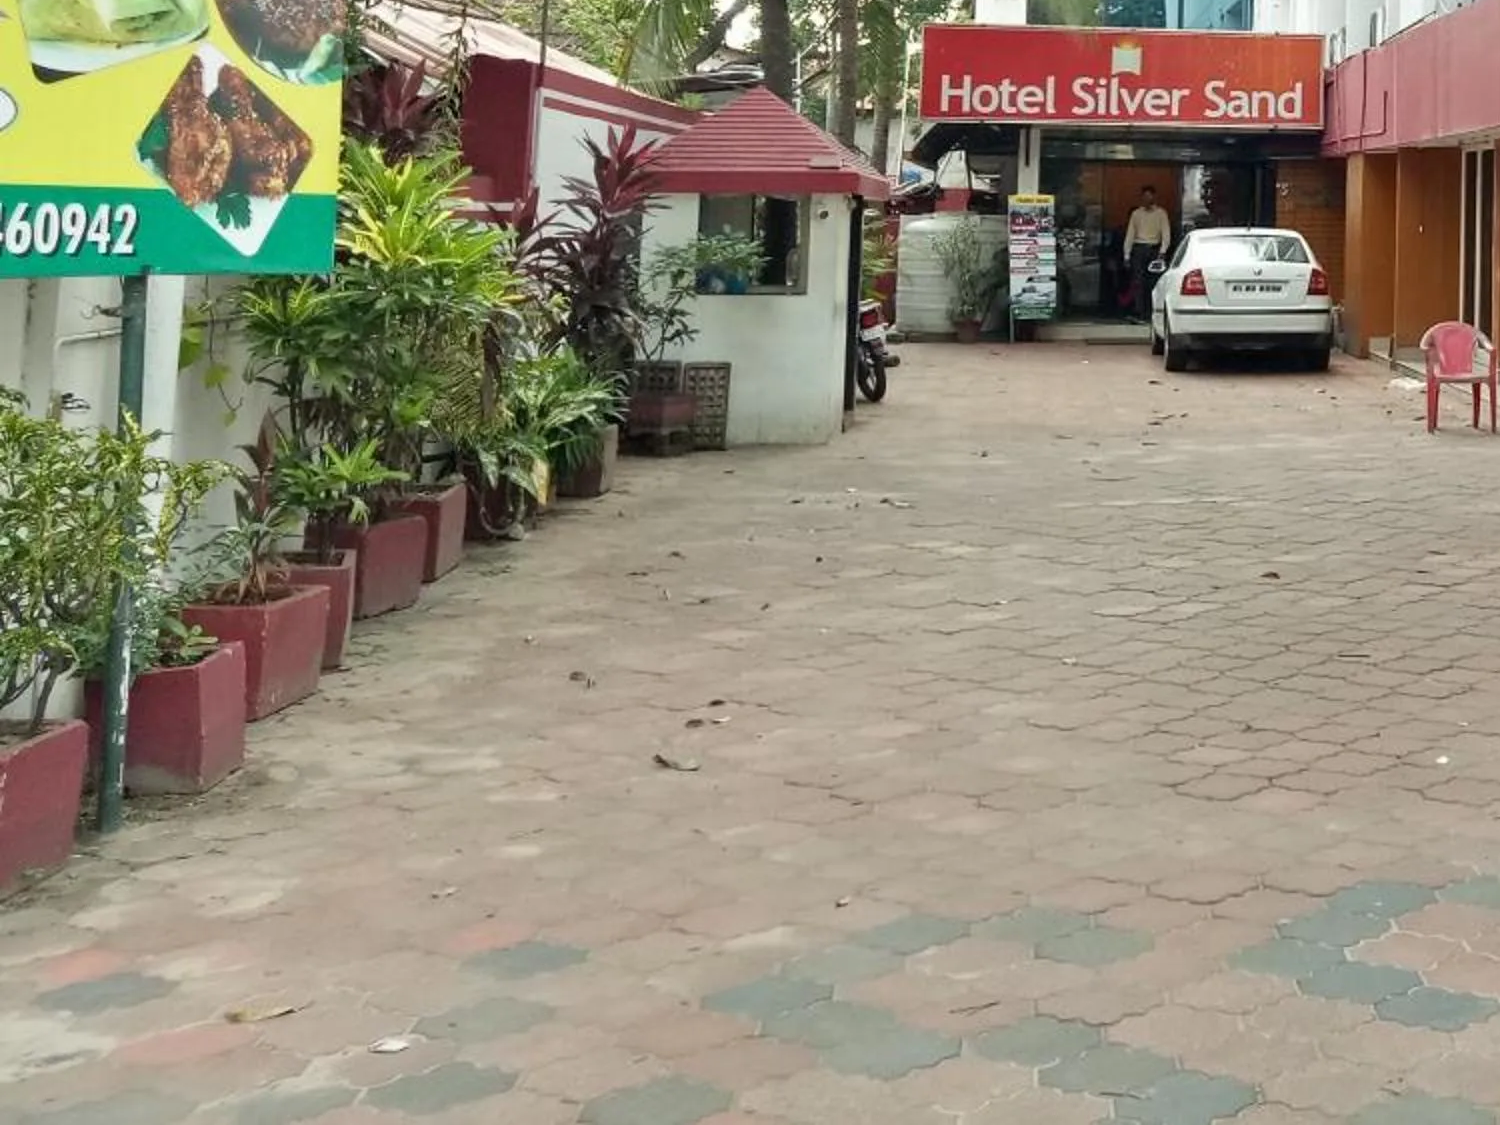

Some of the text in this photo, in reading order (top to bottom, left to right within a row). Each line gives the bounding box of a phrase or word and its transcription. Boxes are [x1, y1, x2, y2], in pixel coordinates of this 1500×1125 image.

[940, 74, 1304, 120] Hotel Silver Sand
